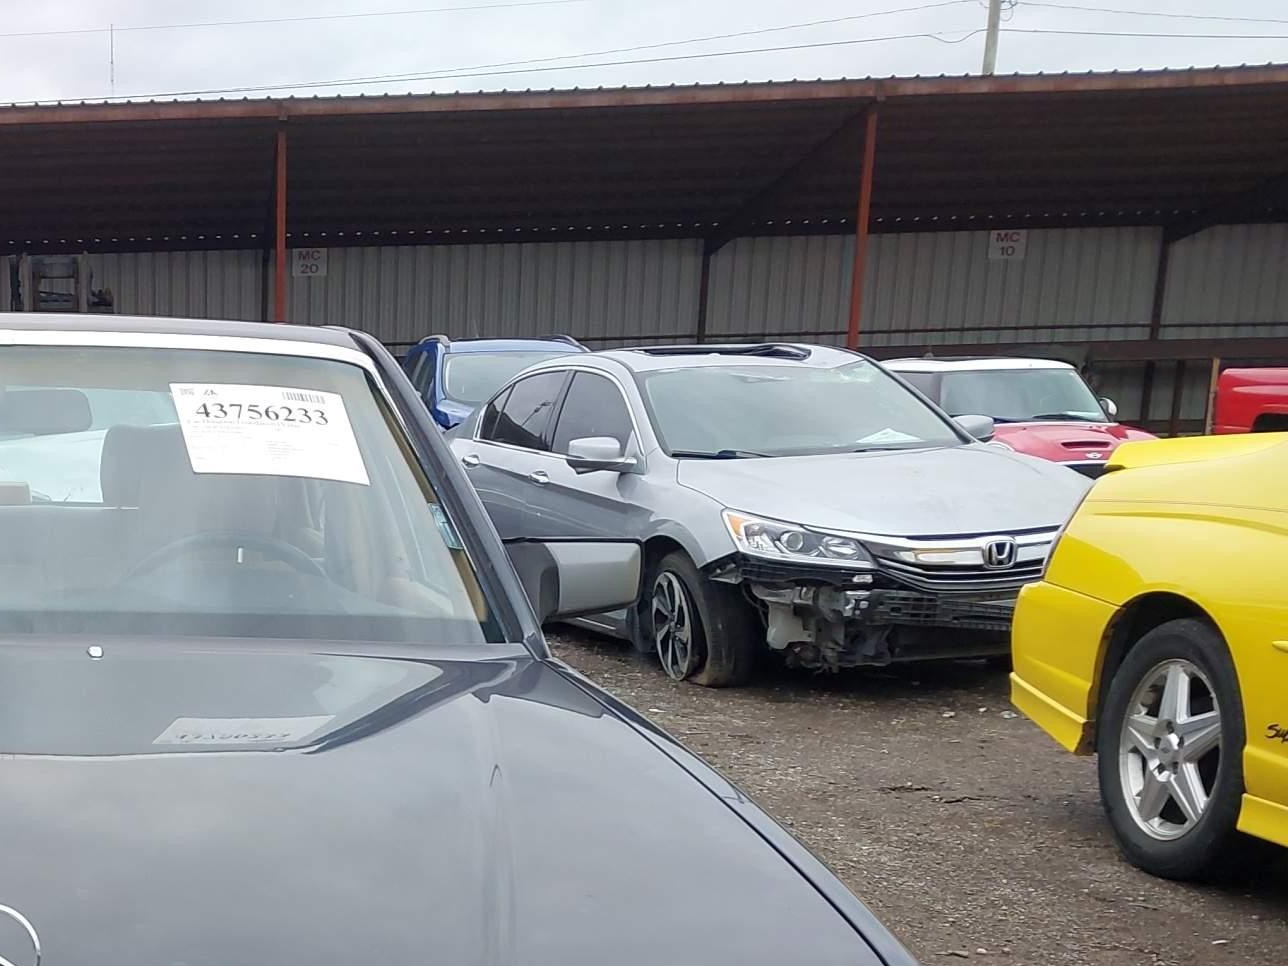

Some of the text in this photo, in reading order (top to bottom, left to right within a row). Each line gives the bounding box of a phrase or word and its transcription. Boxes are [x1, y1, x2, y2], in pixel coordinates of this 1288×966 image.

[996, 231, 1020, 243] MC
[297, 250, 321, 261] MC
[999, 245, 1016, 257] 10
[300, 263, 319, 274] 20
[195, 402, 329, 426] 43756233
